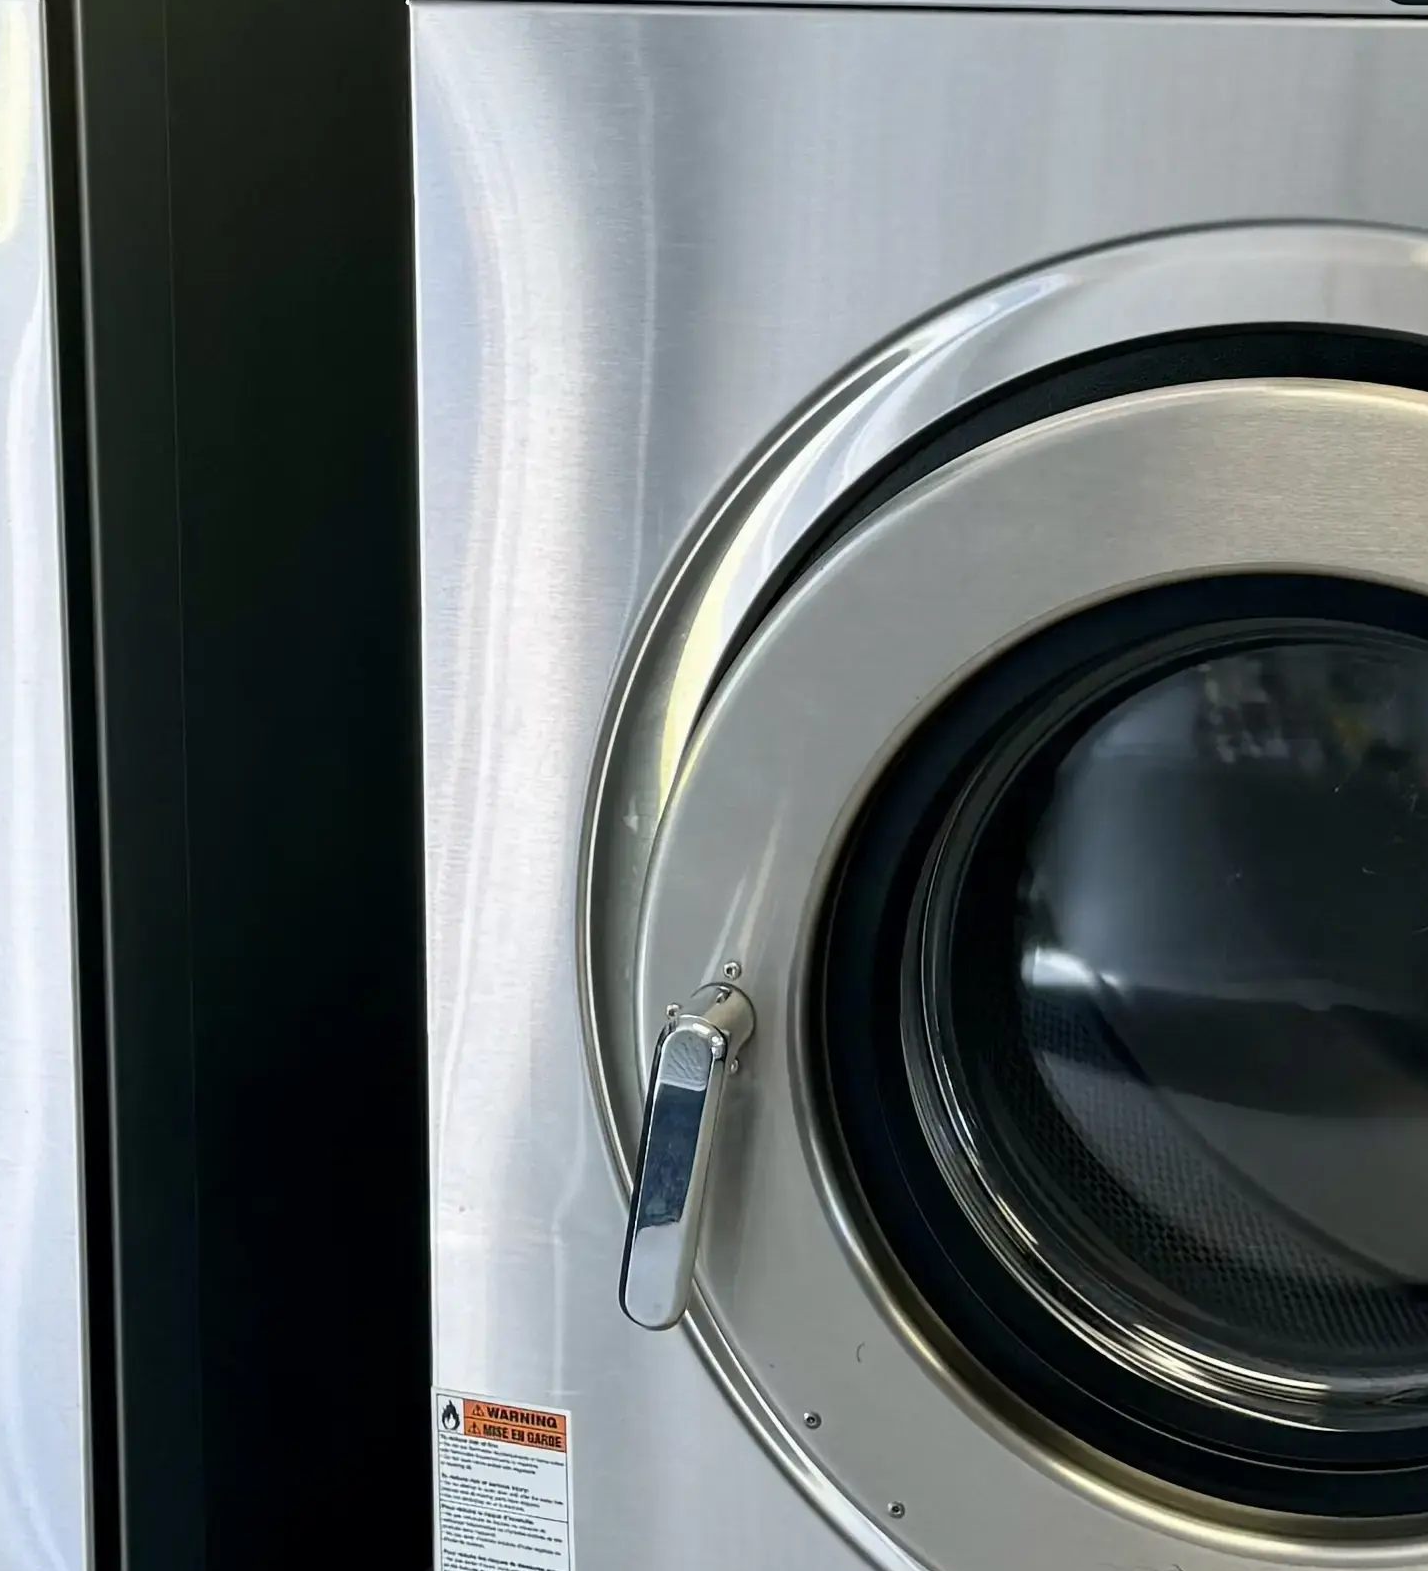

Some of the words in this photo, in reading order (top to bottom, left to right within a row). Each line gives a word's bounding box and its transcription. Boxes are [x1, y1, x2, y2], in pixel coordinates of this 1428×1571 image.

[487, 1406, 558, 1429] WARNING
[483, 1424, 509, 1439] MISE
[511, 1429, 525, 1442] EN
[527, 1432, 562, 1448] GARDE
